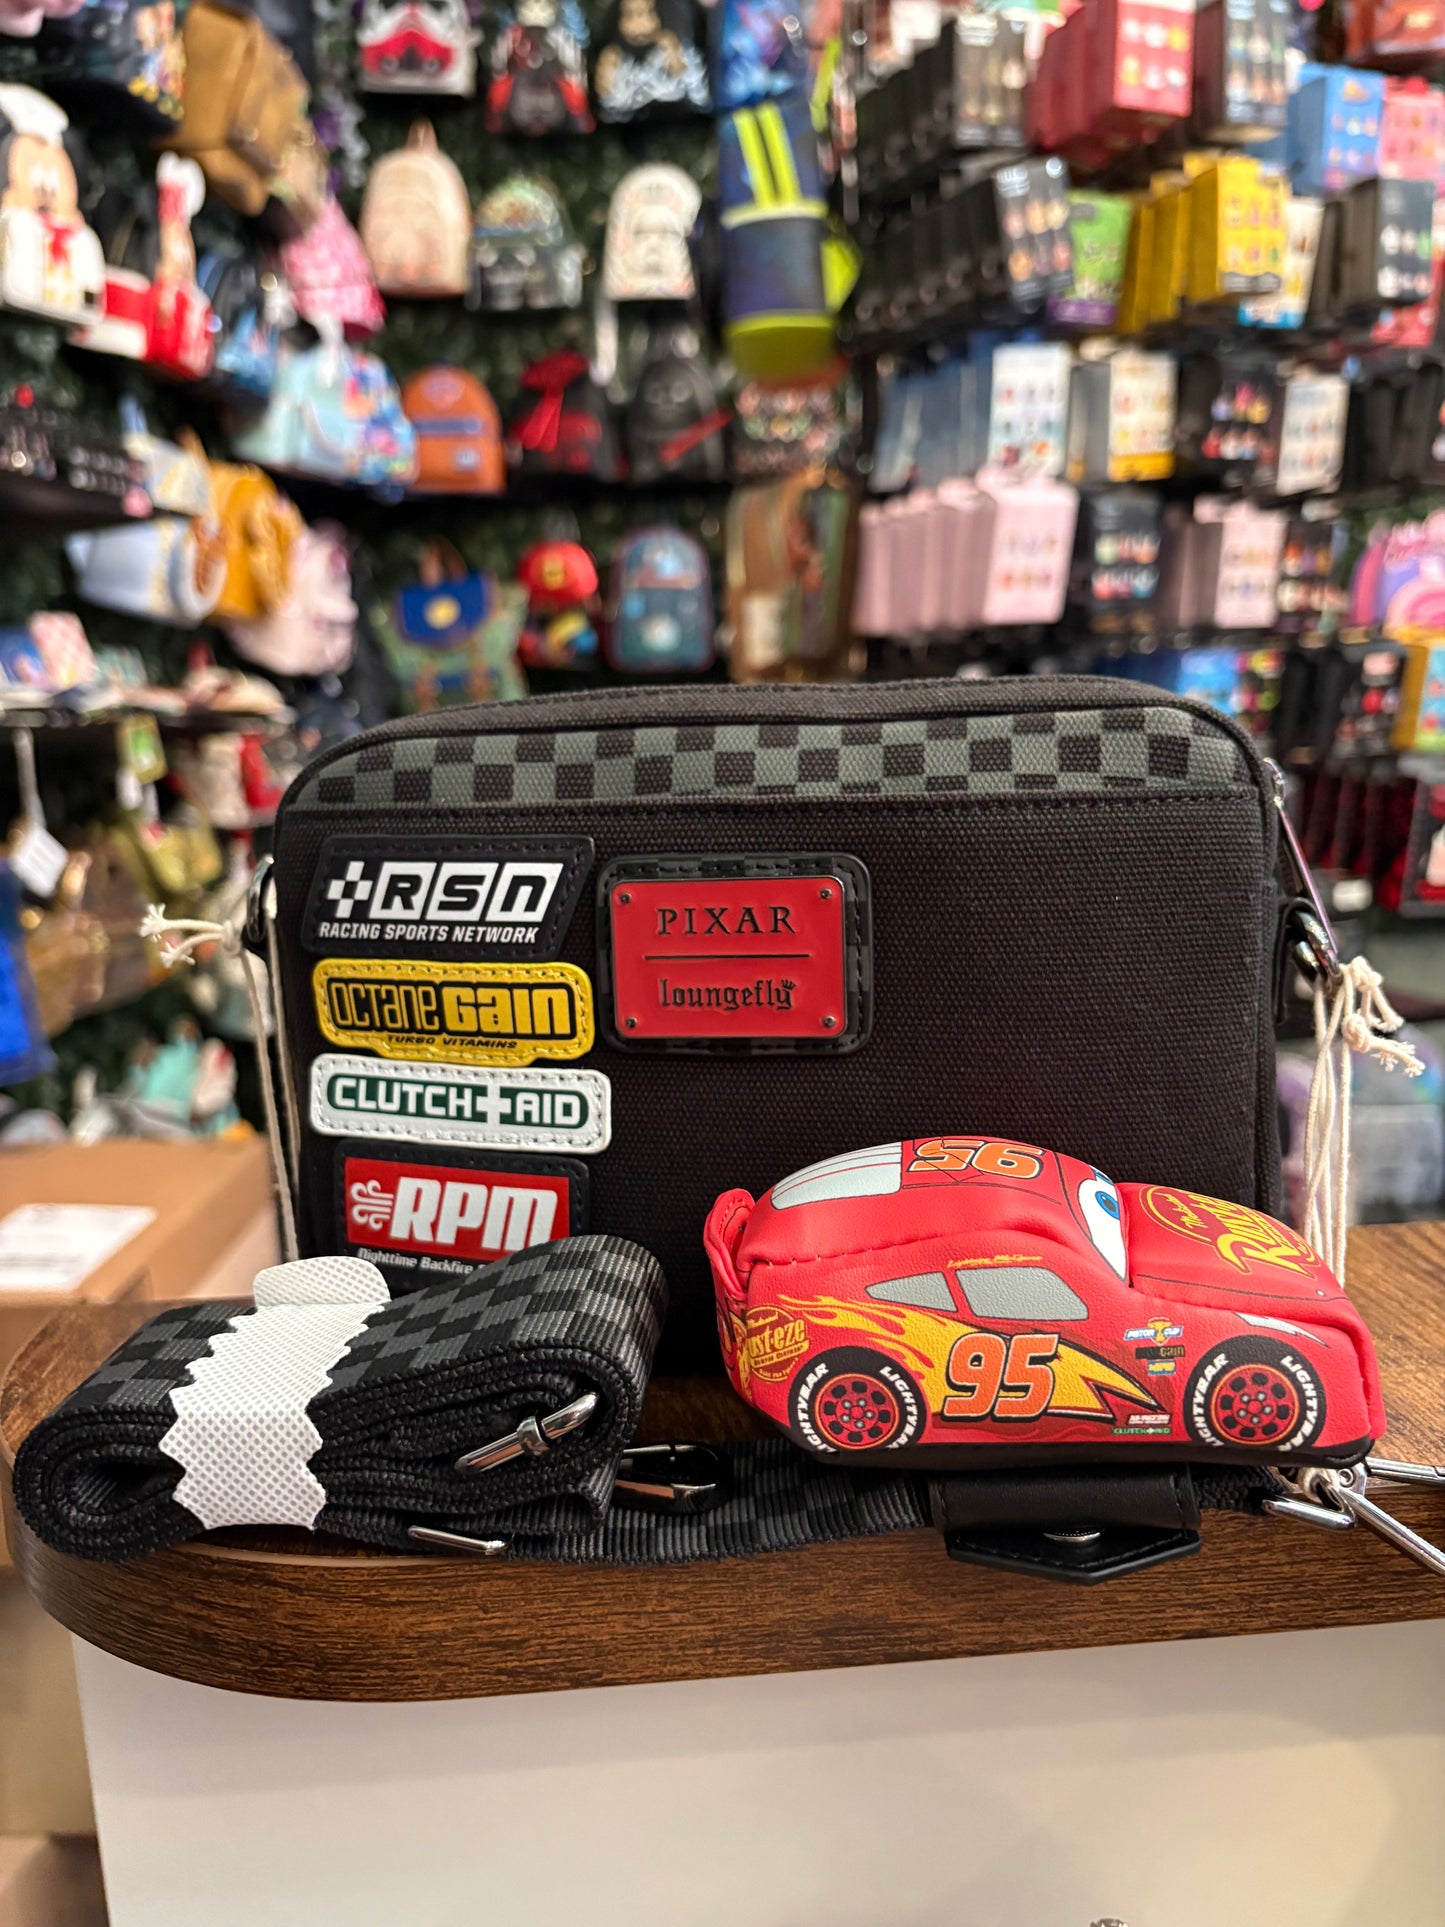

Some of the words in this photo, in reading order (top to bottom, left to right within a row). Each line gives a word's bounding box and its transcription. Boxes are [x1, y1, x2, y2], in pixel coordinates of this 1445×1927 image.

[318, 921, 381, 940] RACING
[384, 924, 450, 942] SPORTS
[452, 926, 540, 944] NETWORK
[657, 906, 796, 936] PIXAR
[658, 978, 797, 1011] loungefly
[387, 1034, 436, 1045] TURBO
[442, 1037, 519, 1049] VITAMINS
[390, 1176, 559, 1252] RPM
[421, 1256, 474, 1275] Backfire
[943, 1332, 1060, 1418] 95
